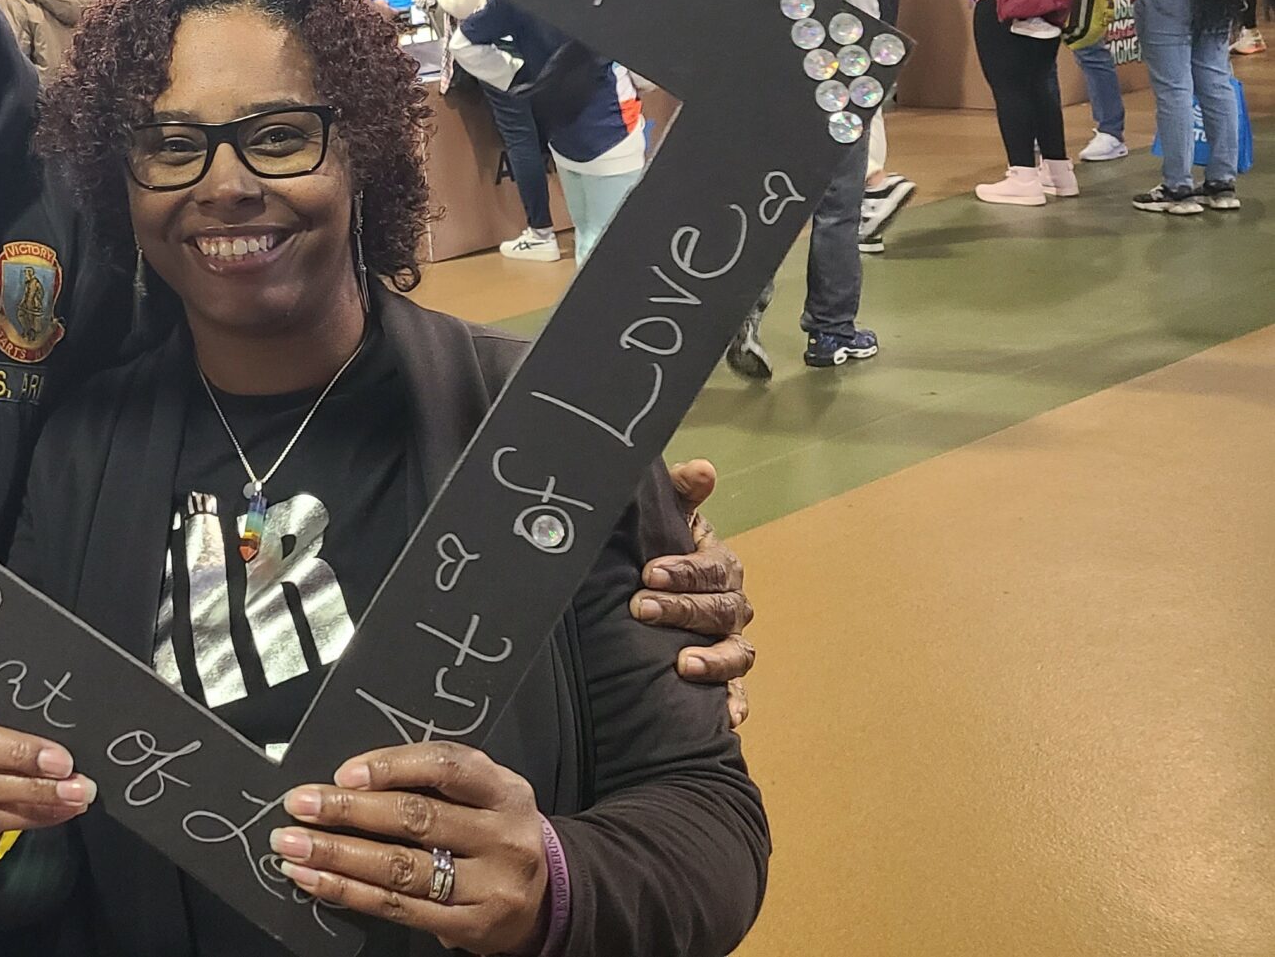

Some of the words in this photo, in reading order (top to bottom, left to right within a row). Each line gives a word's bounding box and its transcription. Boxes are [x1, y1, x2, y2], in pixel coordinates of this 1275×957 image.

[6, 243, 54, 262] VICTORY
[531, 203, 747, 447] Love
[492, 446, 594, 553] of
[106, 729, 203, 807] of
[543, 827, 568, 915] EMPOWERING
